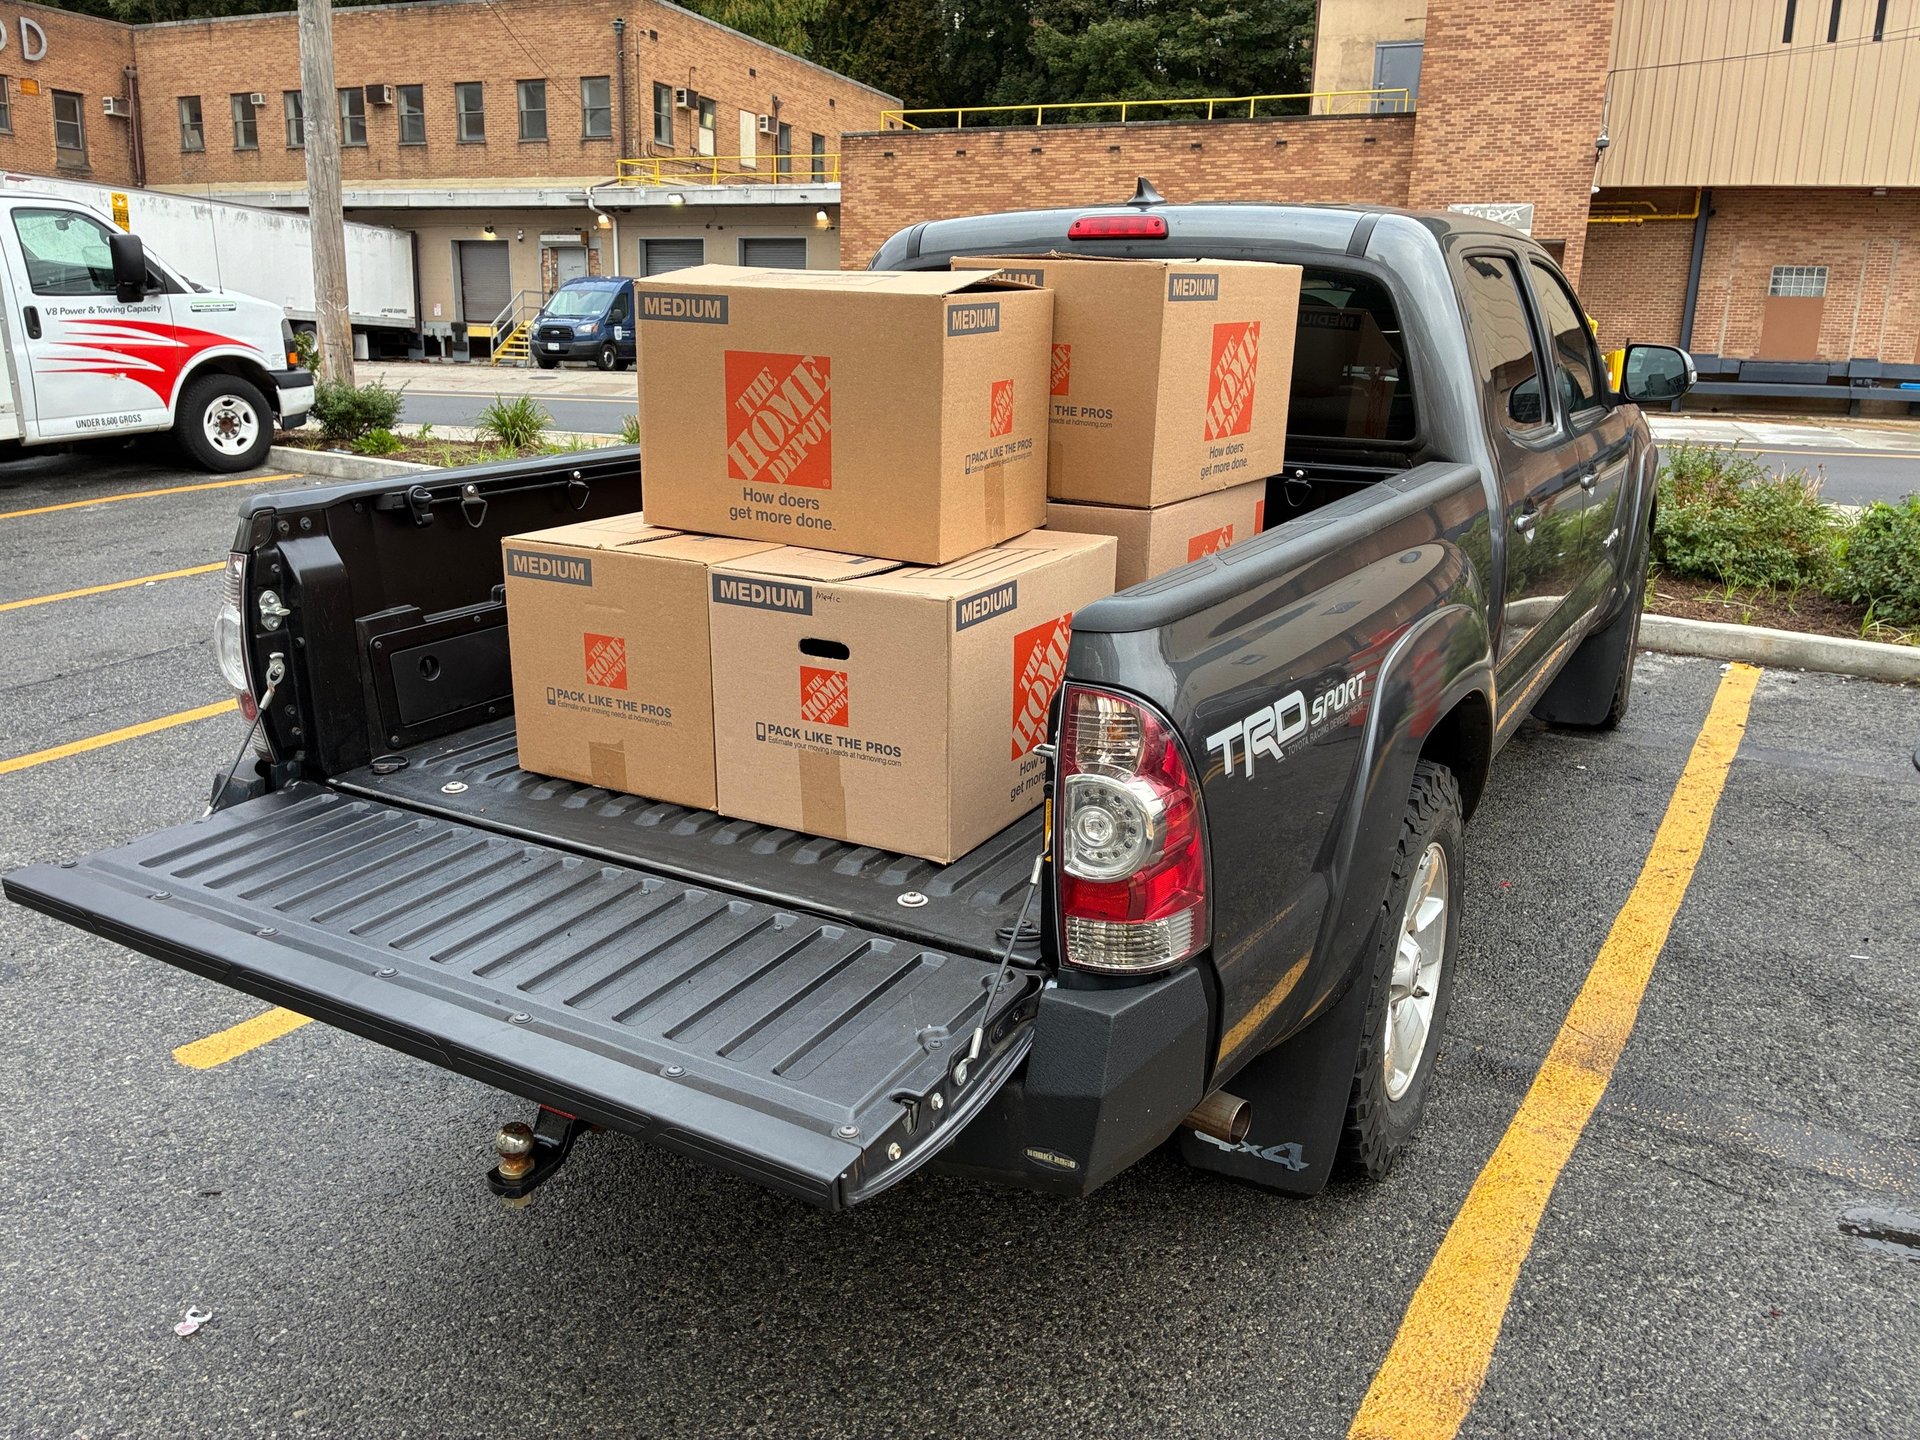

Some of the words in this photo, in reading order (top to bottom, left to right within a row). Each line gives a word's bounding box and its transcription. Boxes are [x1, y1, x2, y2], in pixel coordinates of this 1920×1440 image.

[1173, 278, 1215, 297] MEDIUM
[45, 307, 57, 316] V8
[60, 307, 86, 315] Power
[88, 306, 95, 314] &
[97, 305, 125, 315] Towing
[126, 304, 162, 314] Capacity
[644, 296, 721, 319] MEDIUM
[952, 308, 996, 331] MEDIUM
[1214, 334, 1238, 380] THE
[735, 366, 779, 417] THE
[1206, 322, 1259, 440] HOME
[1055, 405, 1077, 416] THE
[1081, 407, 1113, 419] PROS
[1224, 362, 1256, 437] DEPOT
[75, 418, 100, 429] UNDER
[101, 416, 118, 427] 8,600
[119, 413, 142, 424] GROSS
[728, 355, 832, 480] HOME
[768, 406, 832, 484] DEPOT
[971, 450, 989, 464] PACK
[990, 446, 1003, 459] LIKE
[1005, 442, 1016, 455] THE
[1017, 438, 1032, 451] PROS
[1209, 445, 1225, 459] How
[1225, 442, 1244, 455] doers
[1200, 463, 1212, 480] get
[1213, 461, 1230, 474] more
[743, 487, 774, 504] How
[778, 492, 819, 510] doers
[729, 506, 752, 521] get
[755, 510, 792, 525] more
[512, 554, 585, 581] MEDIUM
[720, 579, 804, 609] MEDIUM
[961, 586, 1013, 625] MEDIUM
[587, 638, 625, 685] HOME
[589, 640, 606, 660] THE
[603, 656, 626, 687] DEPOT
[1019, 638, 1046, 693] THE
[801, 671, 848, 721] HOME
[805, 673, 825, 695] THE
[1012, 615, 1072, 755] HOME
[557, 688, 585, 703] PACK
[588, 694, 613, 708] LIKE
[616, 698, 638, 713] THE
[641, 703, 672, 718] PROS
[557, 700, 579, 710] Estimate
[579, 704, 591, 713] your
[592, 707, 610, 717] moving
[611, 711, 627, 719] needs
[634, 714, 672, 727] hdmoving.com
[819, 693, 849, 724] DEPOT
[1206, 690, 1306, 779] TRD
[1310, 670, 1367, 726] SPORT
[1288, 736, 1309, 756] TOYOTA
[1309, 724, 1330, 743] RACING
[1329, 702, 1364, 731] DEVELOPMENT
[768, 724, 801, 739] PACK
[805, 730, 833, 745] LIKE
[836, 735, 862, 751] THE
[866, 741, 902, 757] PROS
[768, 735, 793, 747] Estimate
[794, 740, 807, 749] your
[808, 744, 830, 755] moving
[831, 747, 849, 757] needs
[849, 750, 856, 759] at
[857, 751, 902, 767] hdmoving.com
[1019, 757, 1039, 777] How
[1010, 779, 1024, 802] get
[1026, 769, 1046, 791] more
